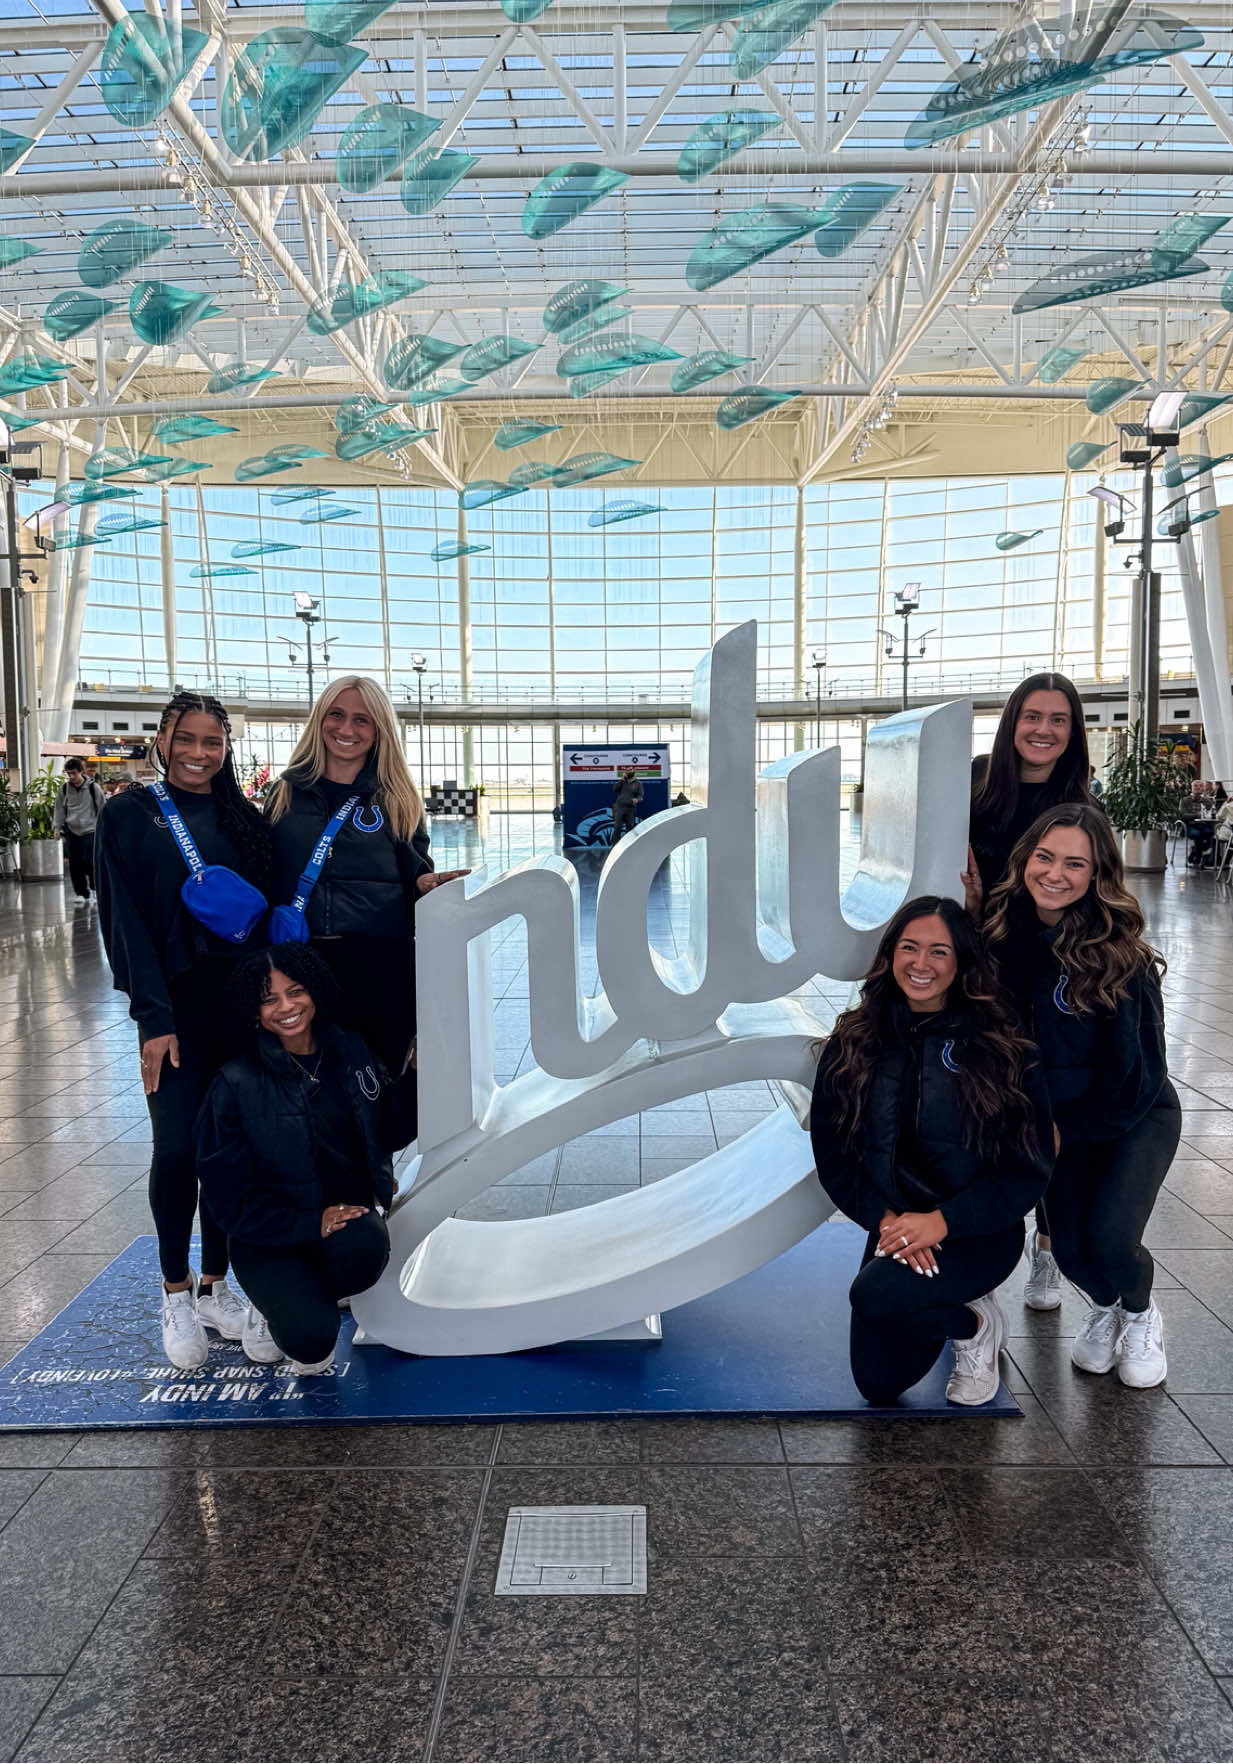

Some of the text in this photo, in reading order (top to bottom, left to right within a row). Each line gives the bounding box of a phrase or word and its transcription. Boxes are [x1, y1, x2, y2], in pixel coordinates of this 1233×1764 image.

[313, 835, 331, 865] COLTS
[139, 1384, 215, 1402] INDY
[217, 1383, 268, 1401] AM
